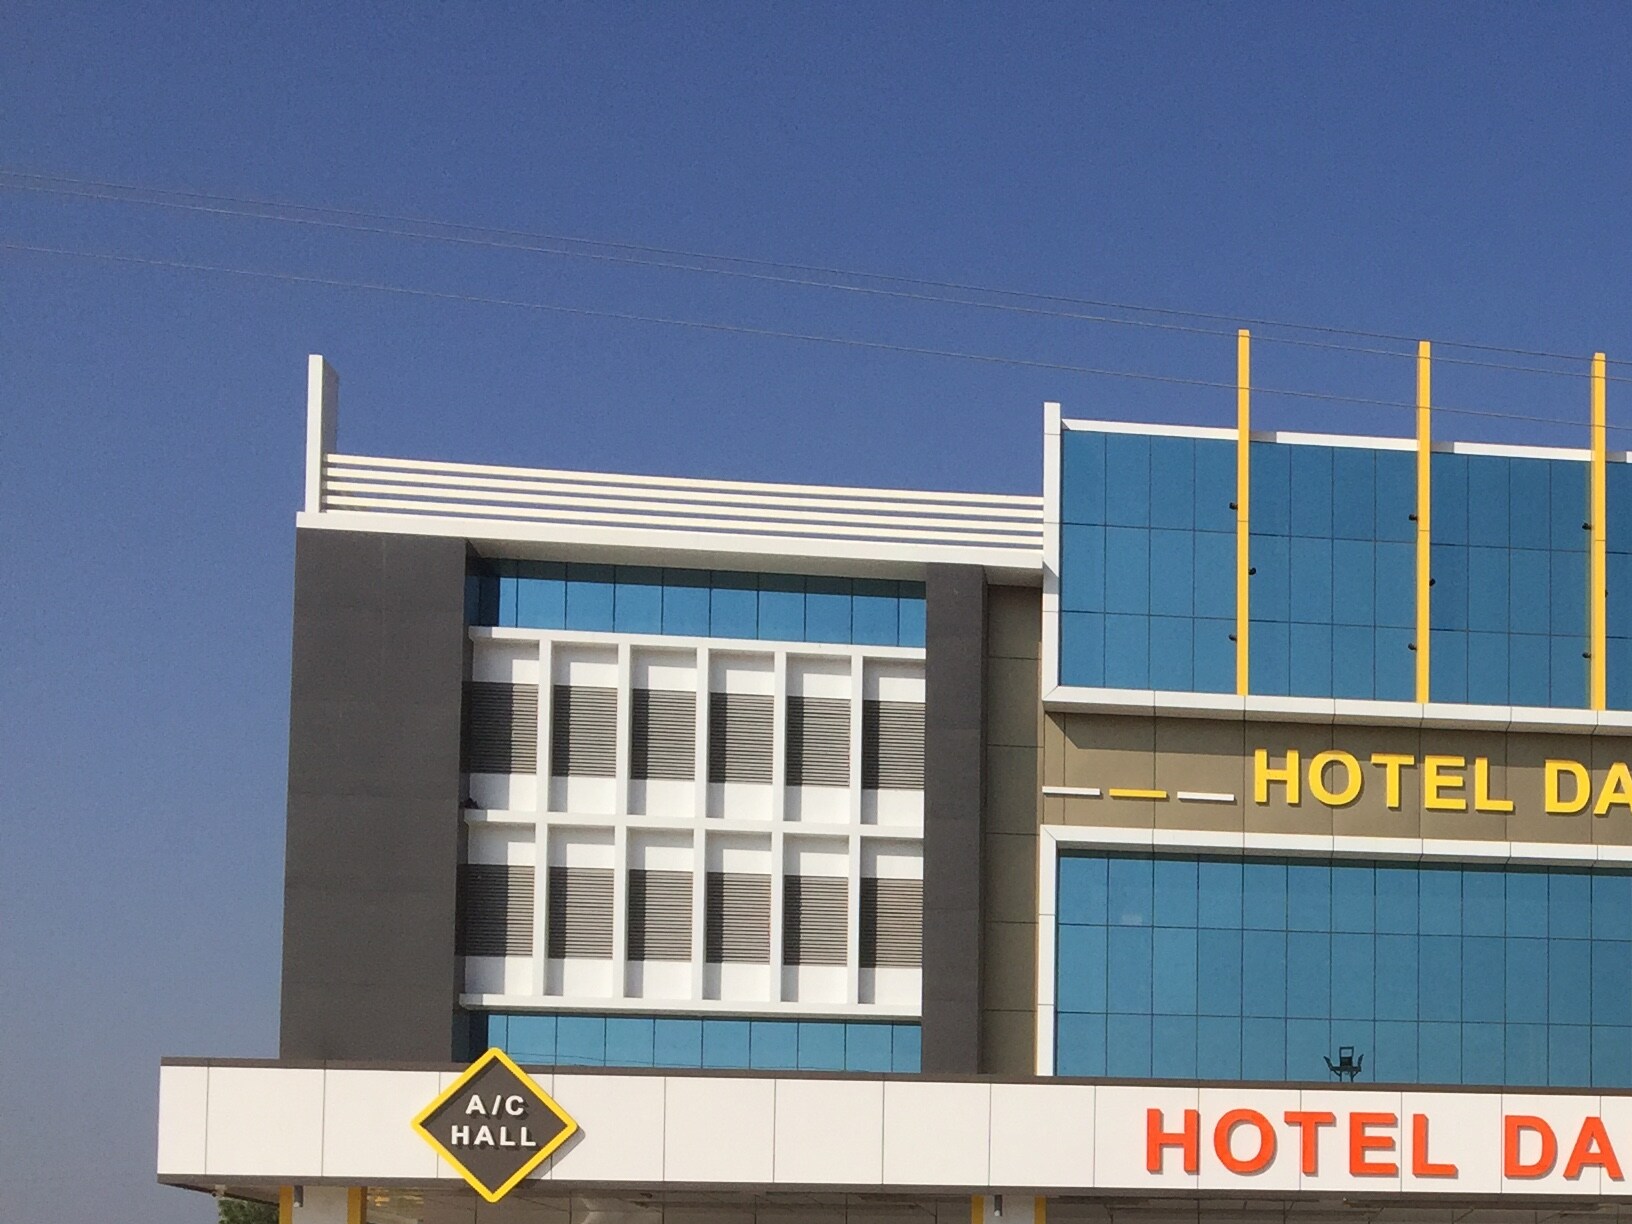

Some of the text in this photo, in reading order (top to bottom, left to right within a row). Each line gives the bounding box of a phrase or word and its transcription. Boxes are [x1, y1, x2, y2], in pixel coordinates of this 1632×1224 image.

[1253, 748, 1515, 813] HOTEL
[465, 1094, 525, 1116] A/C
[451, 1125, 537, 1147] HALL
[1146, 1108, 1458, 1178] HOTEL
